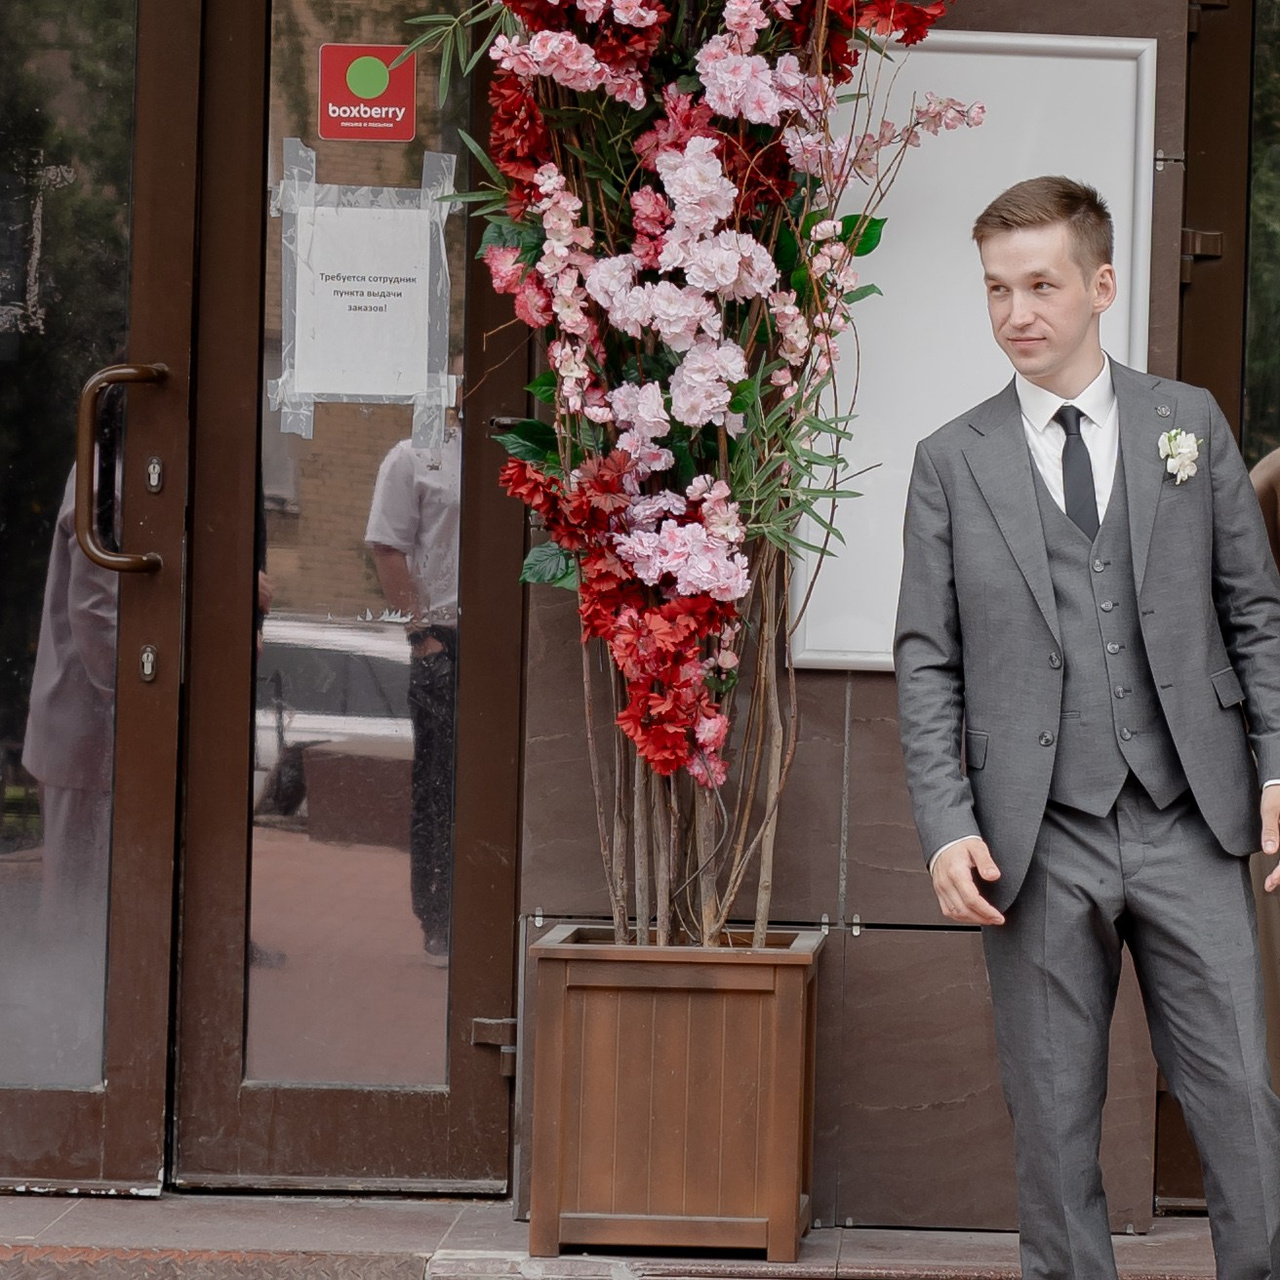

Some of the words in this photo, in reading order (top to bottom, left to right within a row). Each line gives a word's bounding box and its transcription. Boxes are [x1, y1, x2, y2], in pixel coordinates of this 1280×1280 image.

[328, 102, 406, 121] boxberry
[319, 272, 366, 284] Требуется
[368, 274, 418, 285] сотрудник
[333, 289, 365, 299] пункта
[366, 290, 403, 299] выдачи
[347, 304, 388, 313] заказов!
